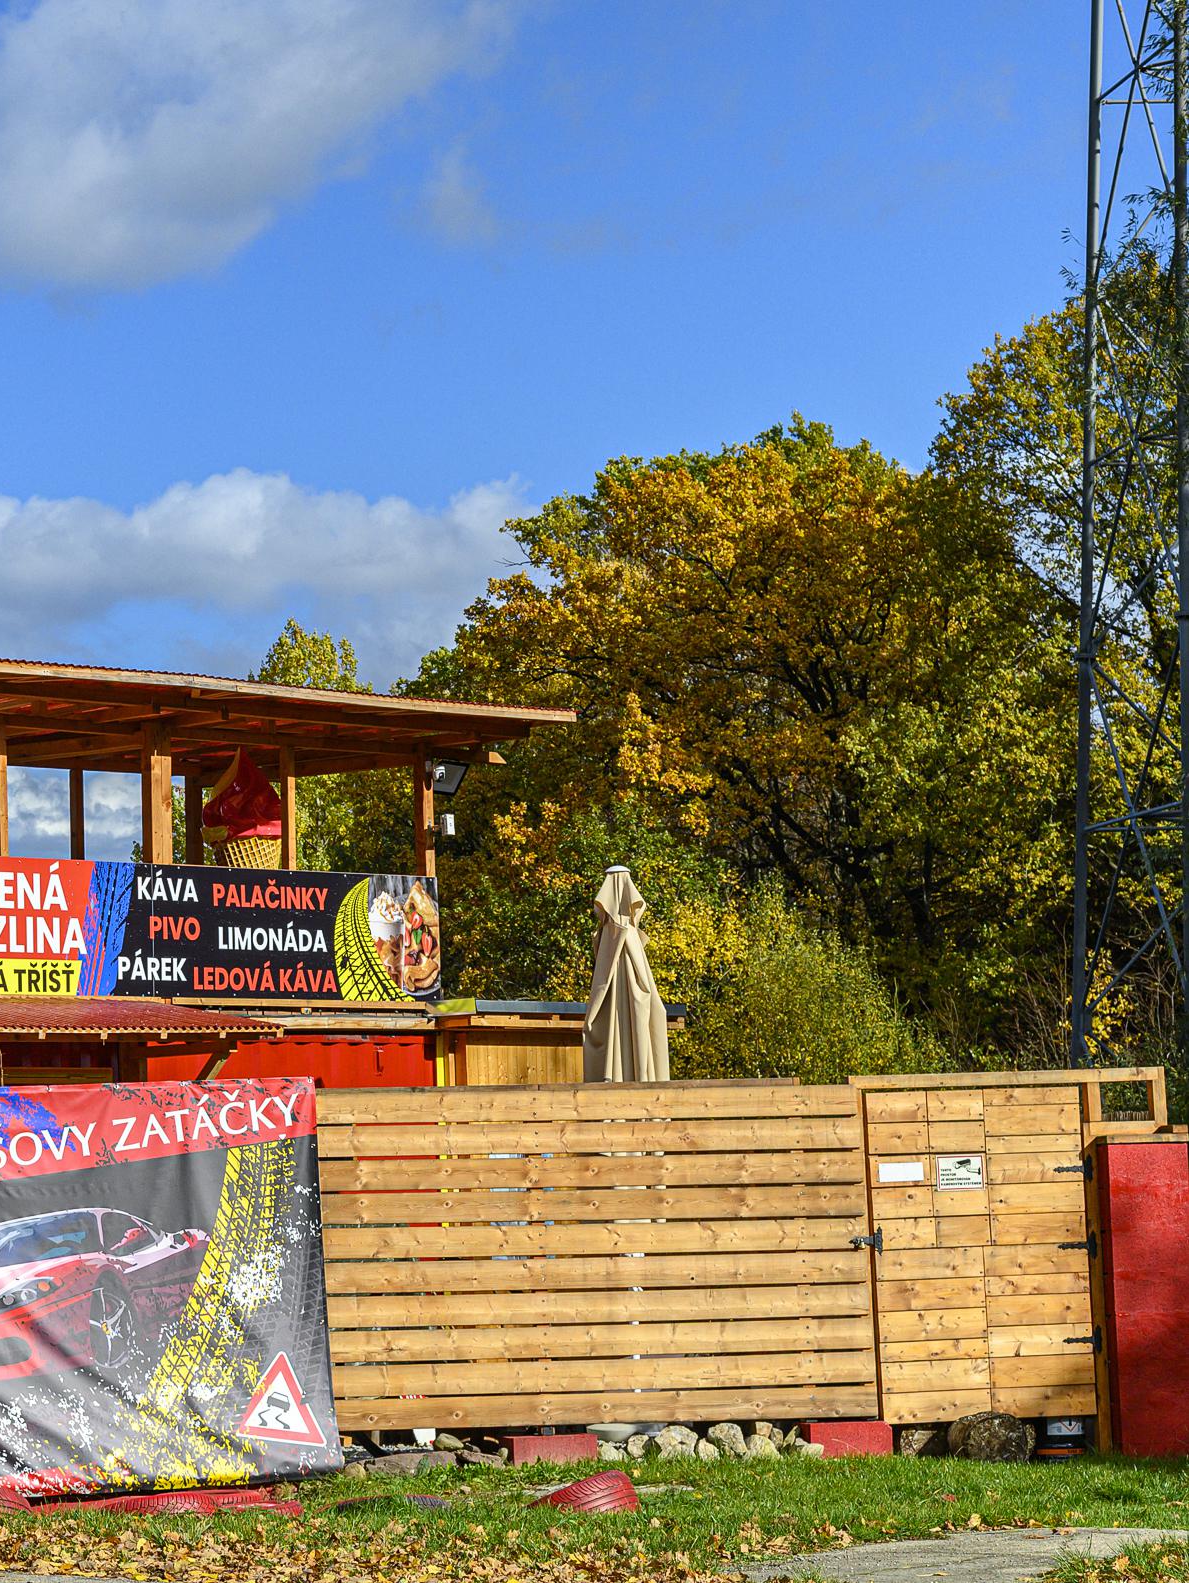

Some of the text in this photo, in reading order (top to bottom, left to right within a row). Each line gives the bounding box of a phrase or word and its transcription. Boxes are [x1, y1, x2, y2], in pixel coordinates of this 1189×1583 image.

[137, 869, 199, 902] KÁVA
[212, 878, 329, 911] PALAČINKY
[149, 915, 201, 941] PIVO
[218, 920, 328, 953] LIMONÁDA
[13, 961, 75, 993] TŘÍŠŤ
[117, 948, 187, 982] PÁREK
[193, 960, 338, 993] LEDOVÁ KÁVA
[112, 1088, 299, 1152] ZATÁČKY
